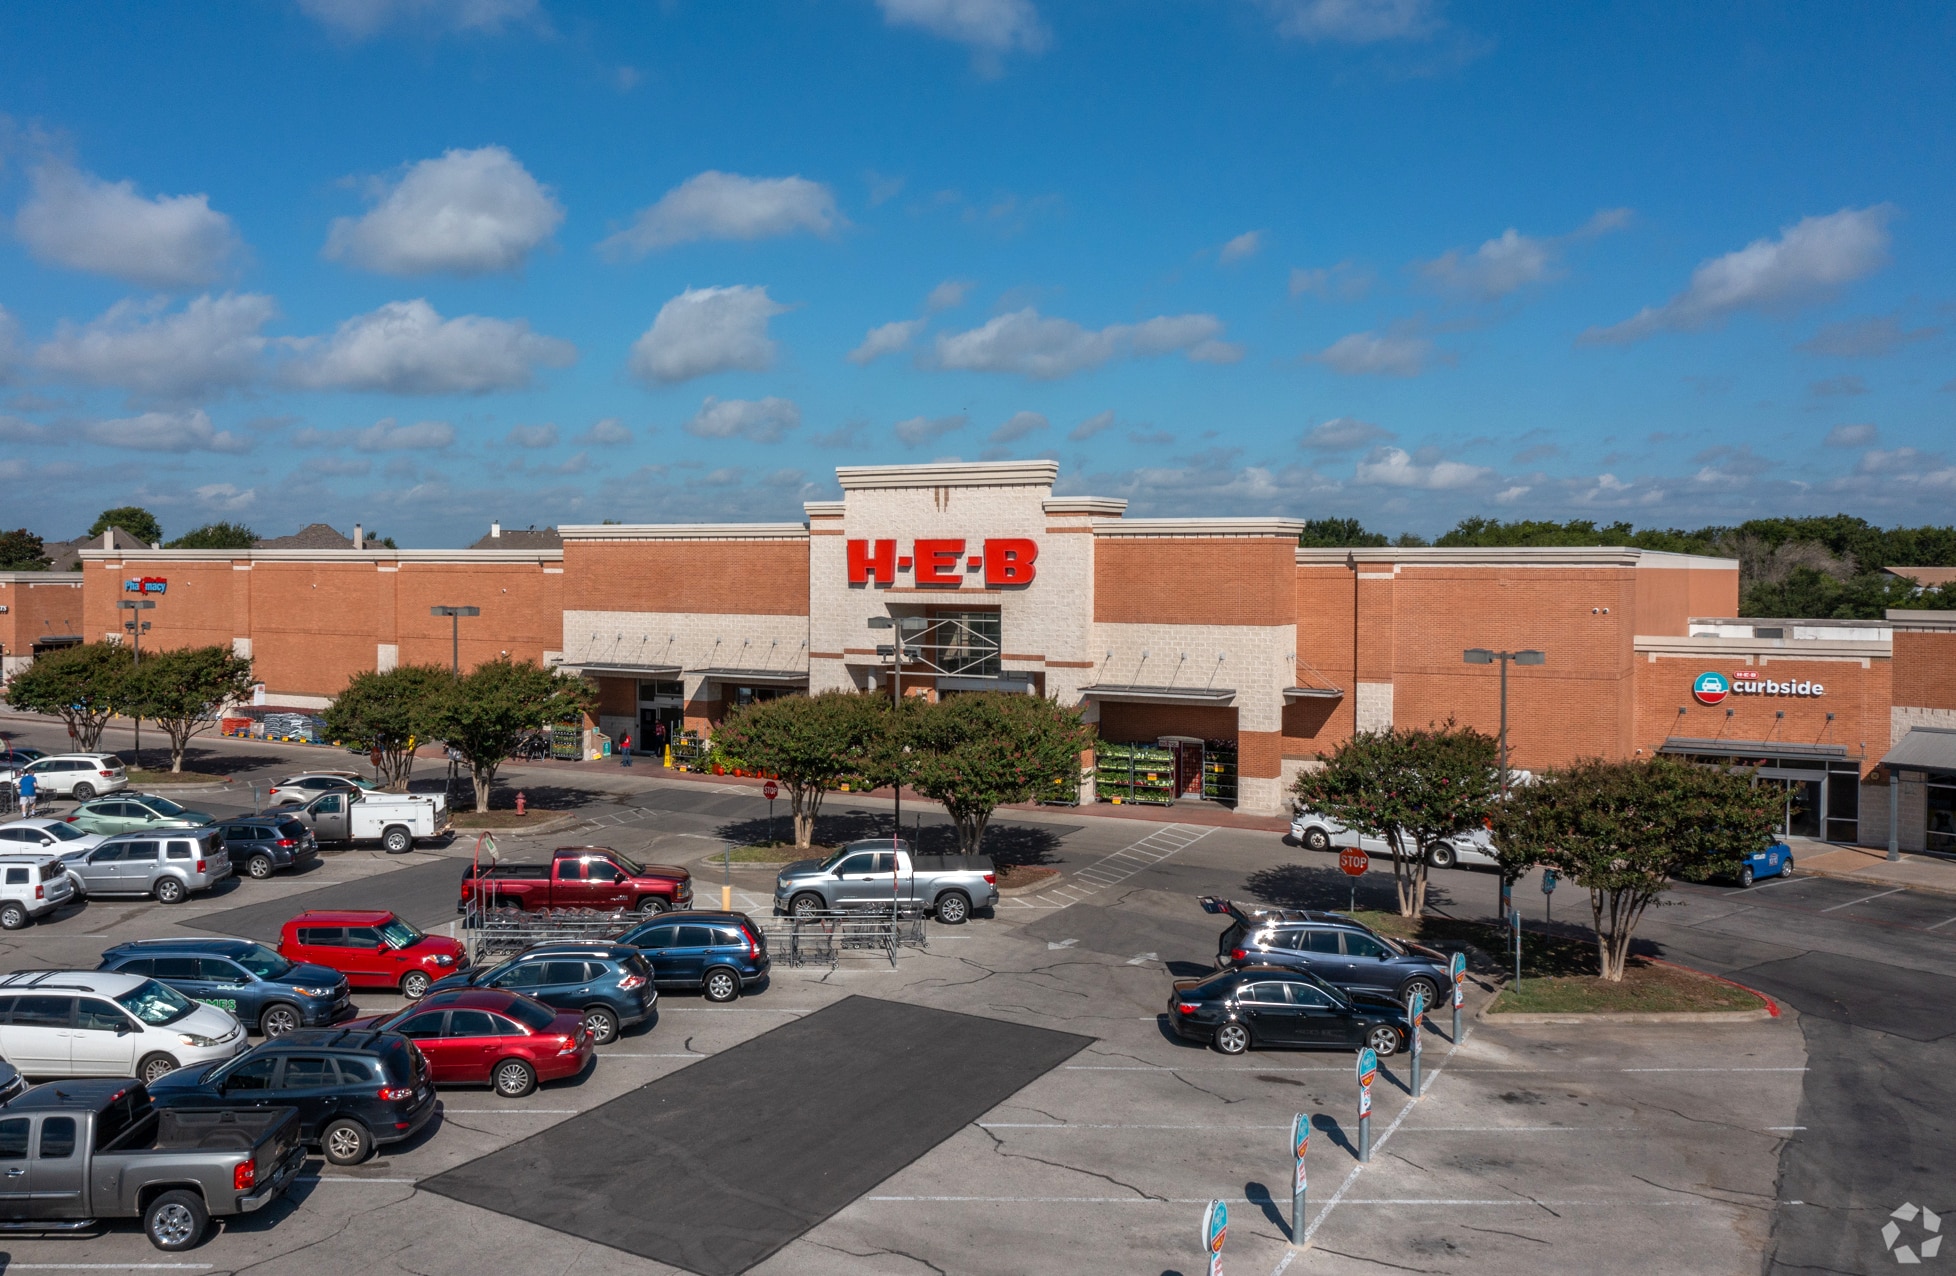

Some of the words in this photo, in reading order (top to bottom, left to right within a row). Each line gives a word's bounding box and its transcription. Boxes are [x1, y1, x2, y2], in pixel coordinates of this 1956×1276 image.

[847, 538, 1038, 584] H-E-B
[1732, 679, 1824, 695] curbside
[763, 786, 778, 795] STOP
[1341, 855, 1367, 868] STOP
